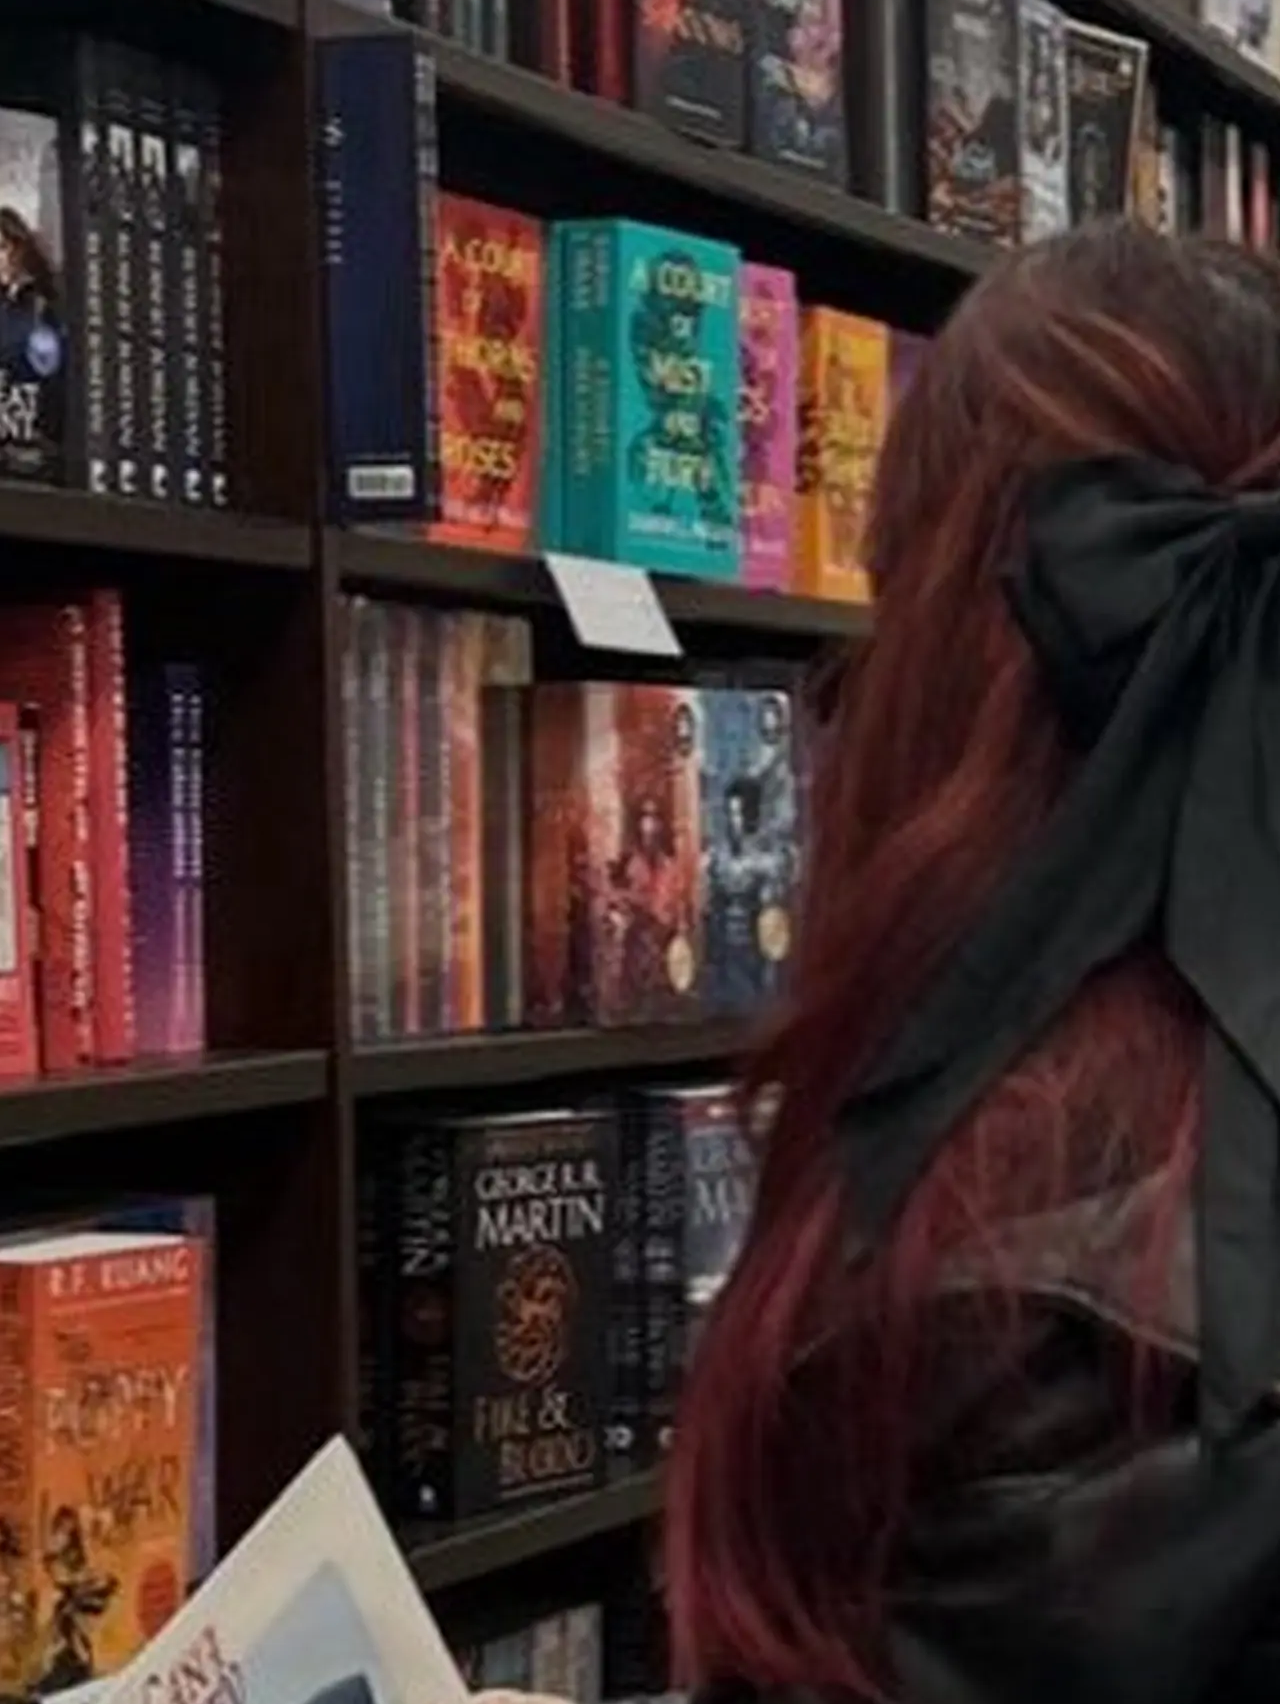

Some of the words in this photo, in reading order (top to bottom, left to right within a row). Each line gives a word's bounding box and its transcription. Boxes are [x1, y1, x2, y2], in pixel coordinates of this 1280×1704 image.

[655, 258, 734, 305] COURT
[648, 350, 714, 394] MIST
[441, 435, 520, 480] ROSES
[474, 1161, 557, 1203] GEORGE
[473, 1194, 605, 1252] MARTIN
[98, 1249, 191, 1292] KUANG
[474, 1392, 532, 1444] FIRE
[538, 1384, 569, 1431] &
